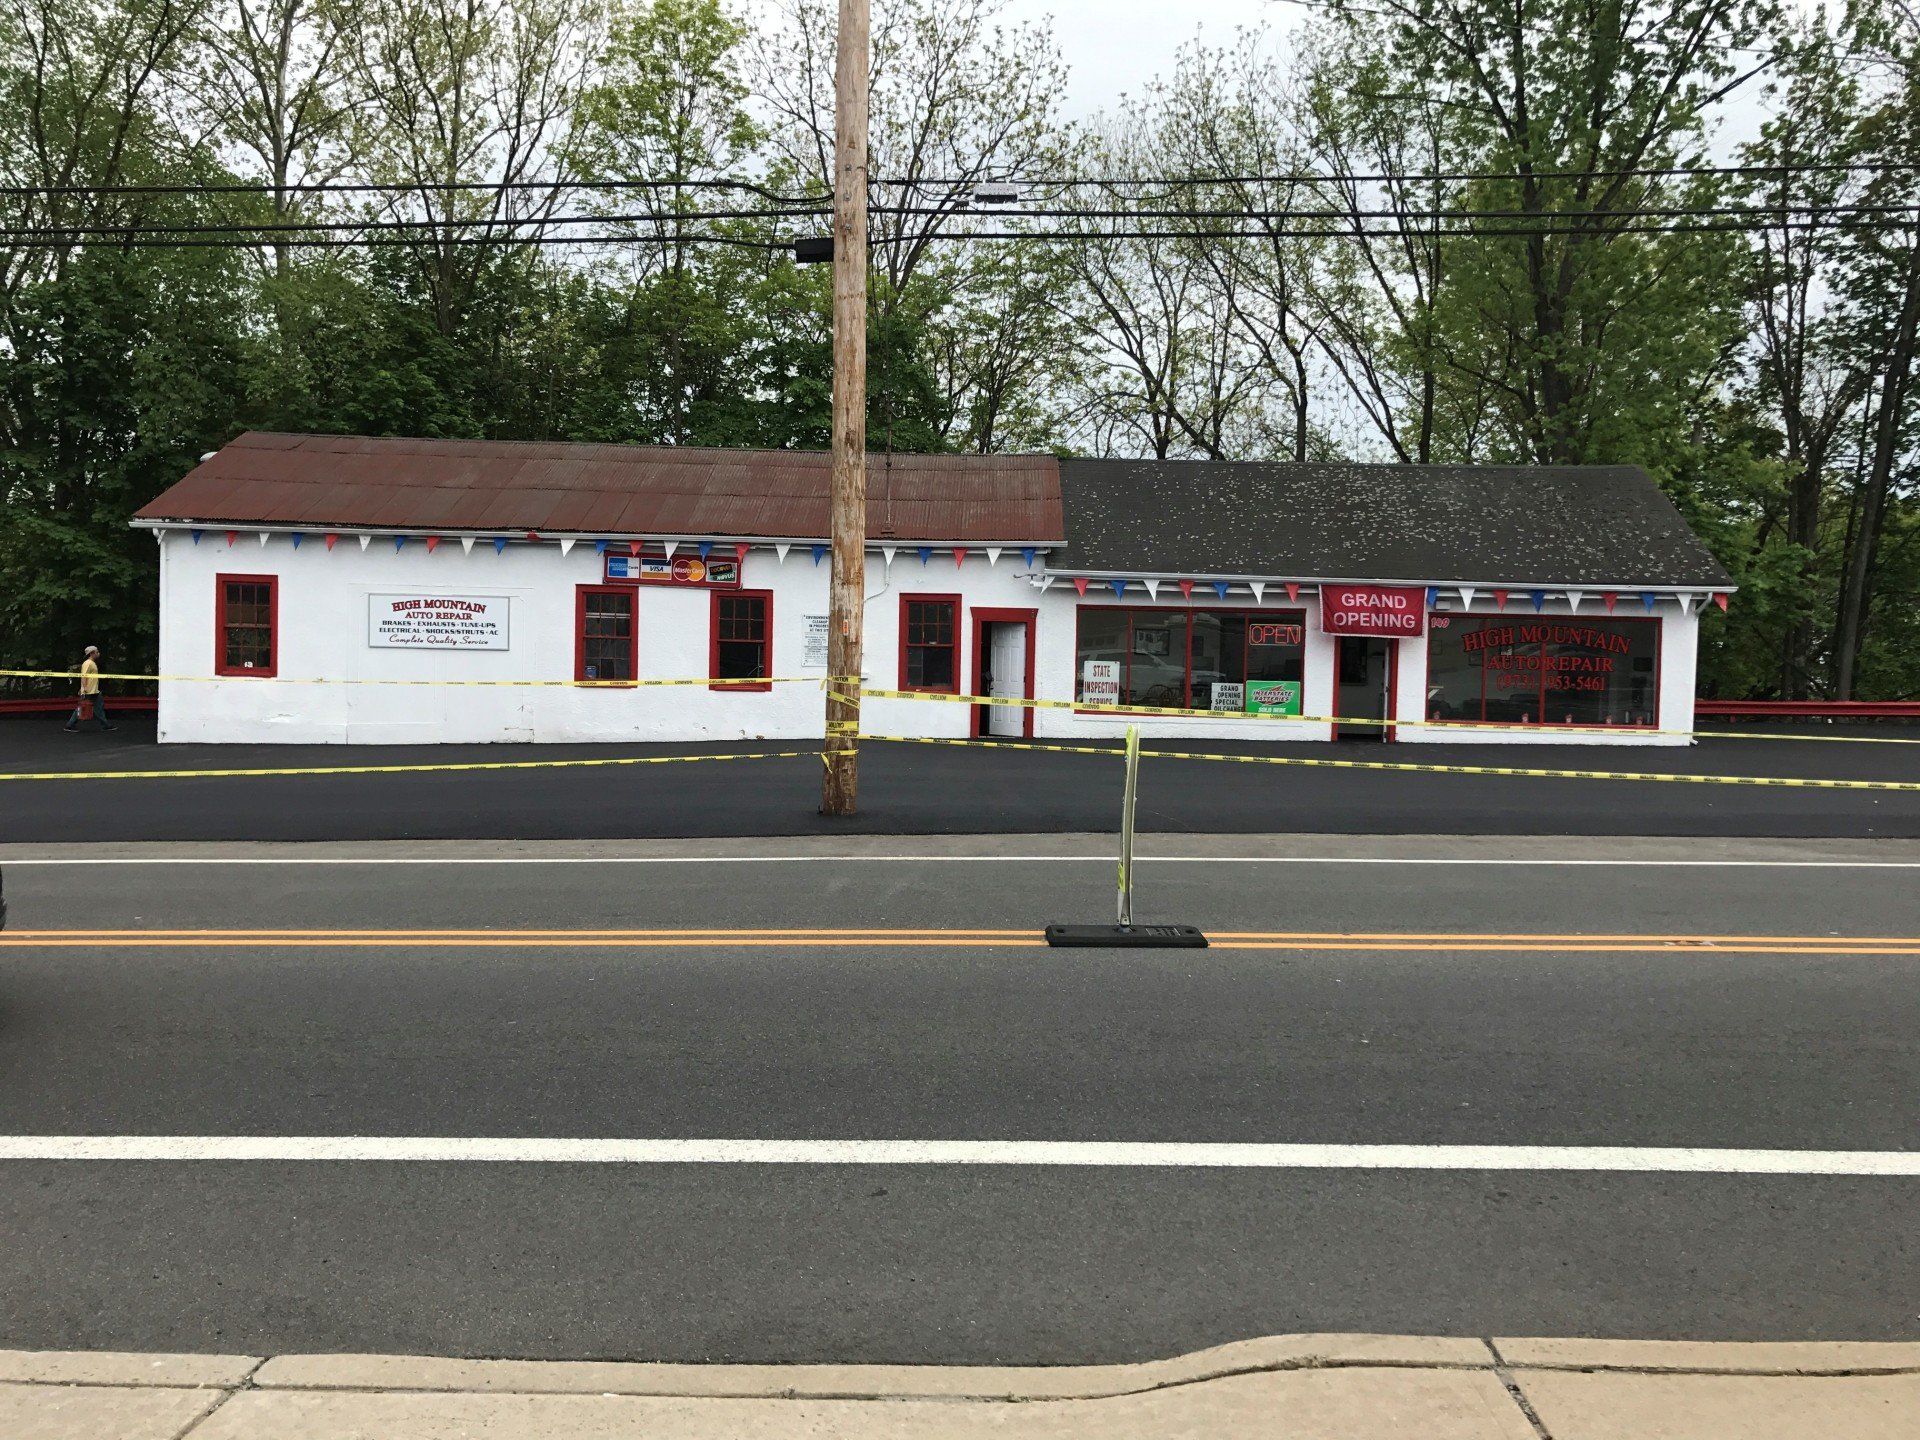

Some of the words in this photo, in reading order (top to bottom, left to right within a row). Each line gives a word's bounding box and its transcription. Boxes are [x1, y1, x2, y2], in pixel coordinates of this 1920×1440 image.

[392, 600, 420, 612] HIGH
[424, 599, 486, 614] MOUNTAIN
[1341, 593, 1406, 609] GRAND
[1334, 612, 1416, 628] OPENING
[389, 634, 424, 644] Complete
[426, 635, 457, 645] Quality
[459, 636, 488, 644] Service
[1252, 625, 1300, 644] OPEN
[1463, 627, 1514, 652] HIGH
[1519, 624, 1632, 654] MOUNTAIN
[1093, 665, 1110, 677] STATE
[1488, 656, 1540, 670] AUTO
[1544, 656, 1614, 672] REPAIR
[1084, 682, 1118, 693] INSPECTION
